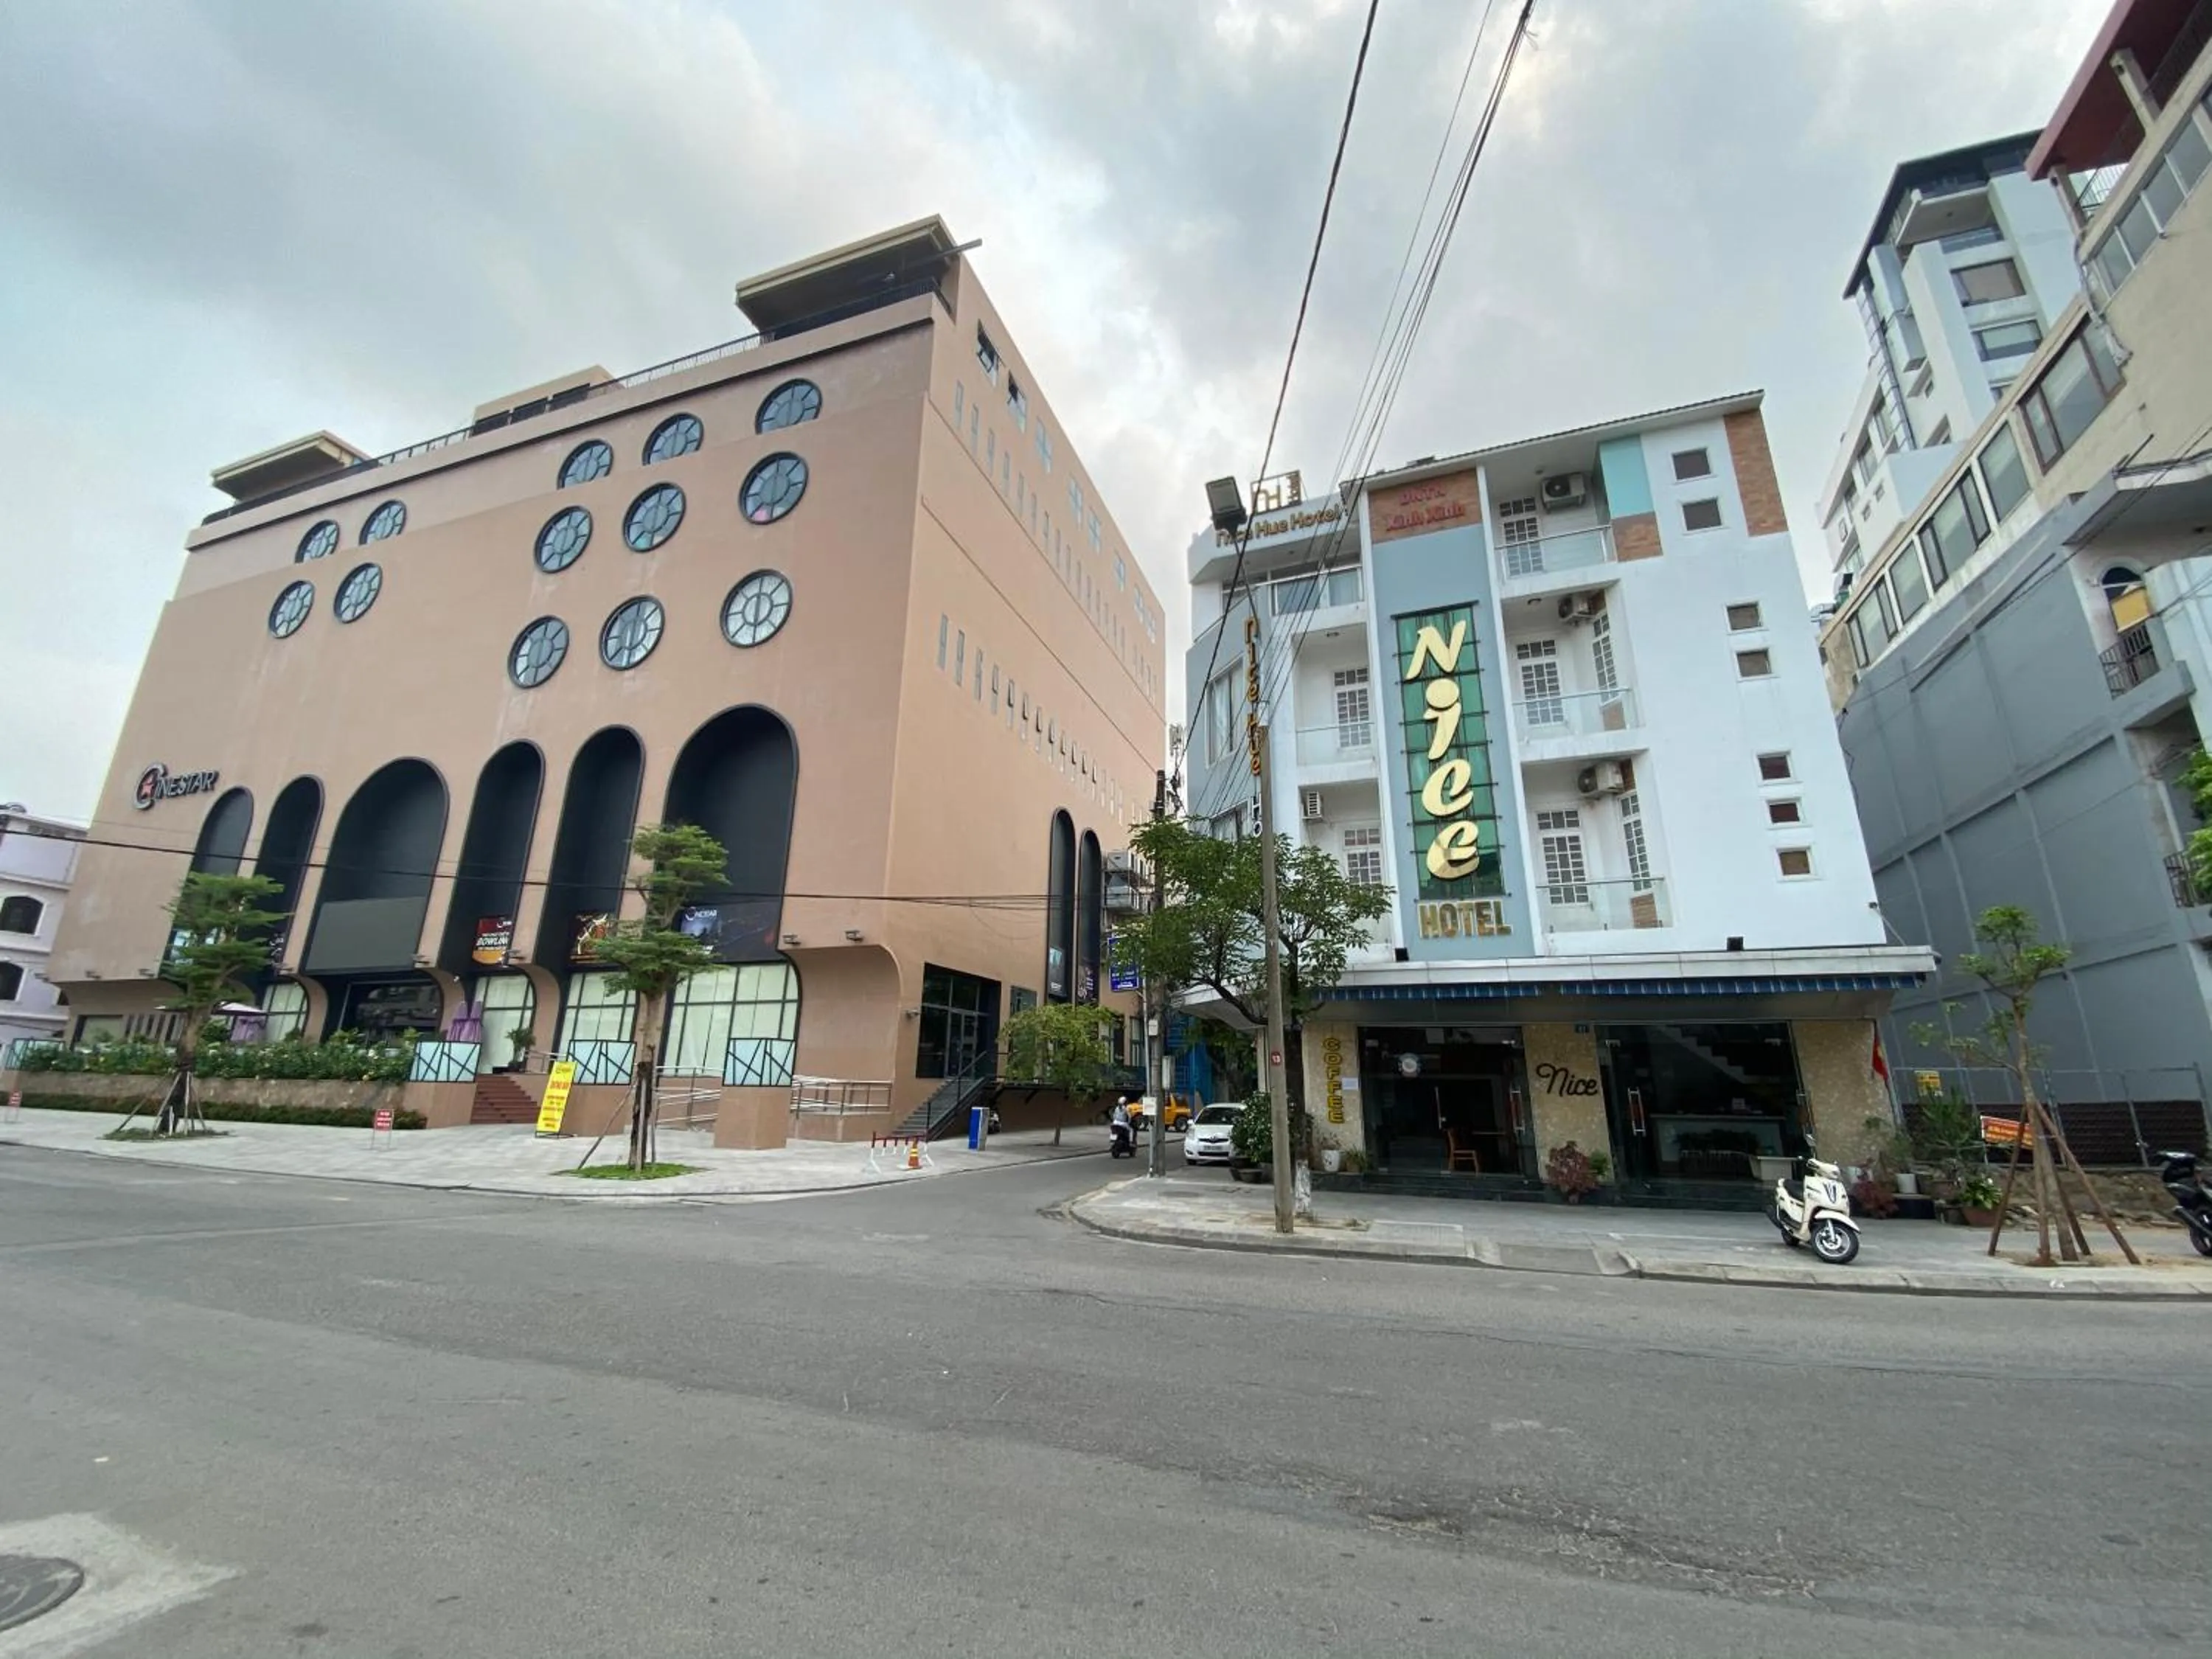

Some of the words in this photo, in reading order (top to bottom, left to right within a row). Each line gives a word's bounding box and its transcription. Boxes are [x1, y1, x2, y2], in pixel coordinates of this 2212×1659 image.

[1255, 519, 1287, 539] Hue
[1405, 620, 1480, 880] Nice
[133, 762, 220, 810] CINESTAR
[1419, 900, 1512, 939] HOTEL
[1323, 1037, 1345, 1124] COFFEE
[1536, 1062, 1598, 1097] Nice
